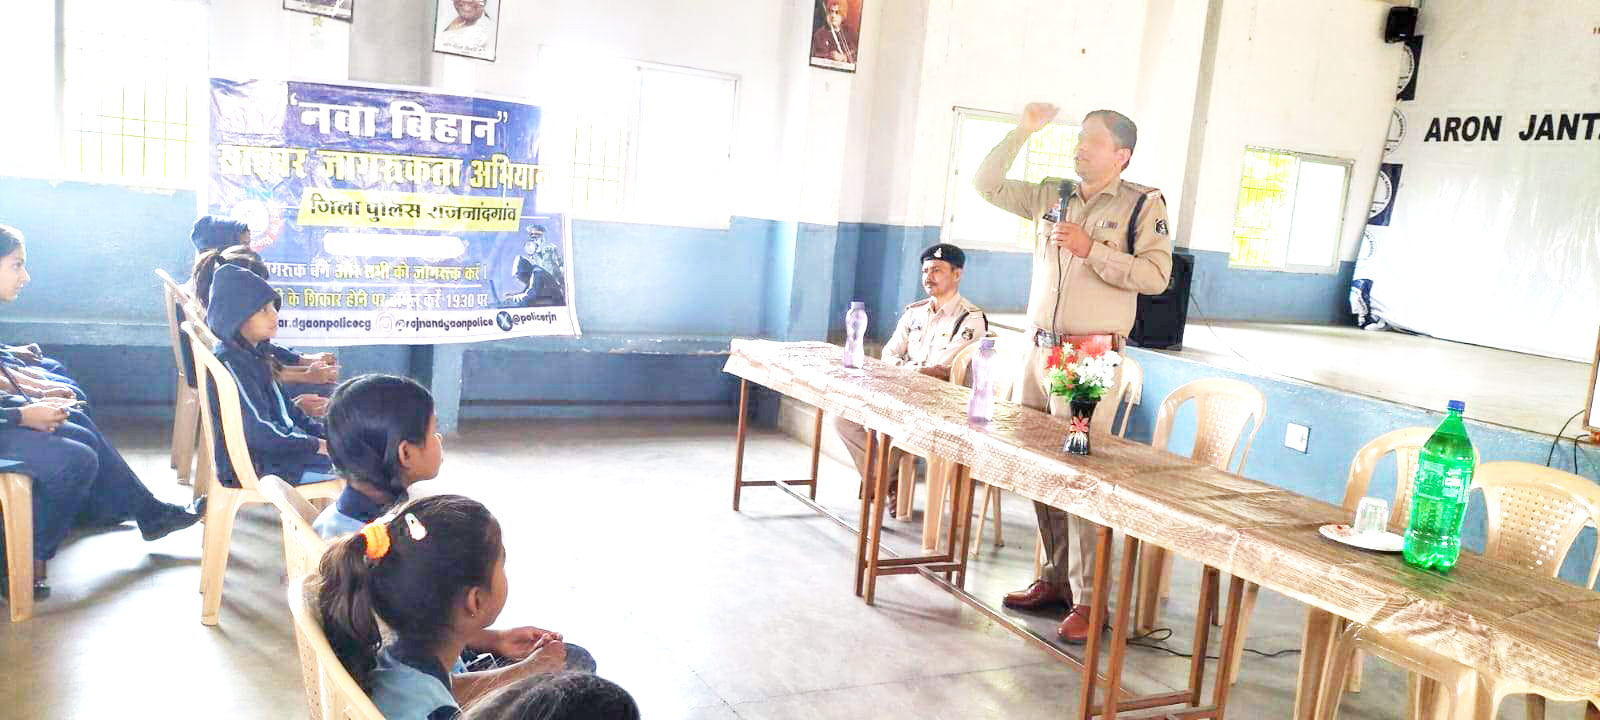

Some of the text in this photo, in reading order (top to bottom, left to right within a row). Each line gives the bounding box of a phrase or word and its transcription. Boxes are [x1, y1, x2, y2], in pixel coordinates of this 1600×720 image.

[1424, 115, 1503, 142] ARON
[1518, 113, 1600, 141] JANT
[310, 192, 361, 216] जिला
[446, 293, 475, 309] 1930
